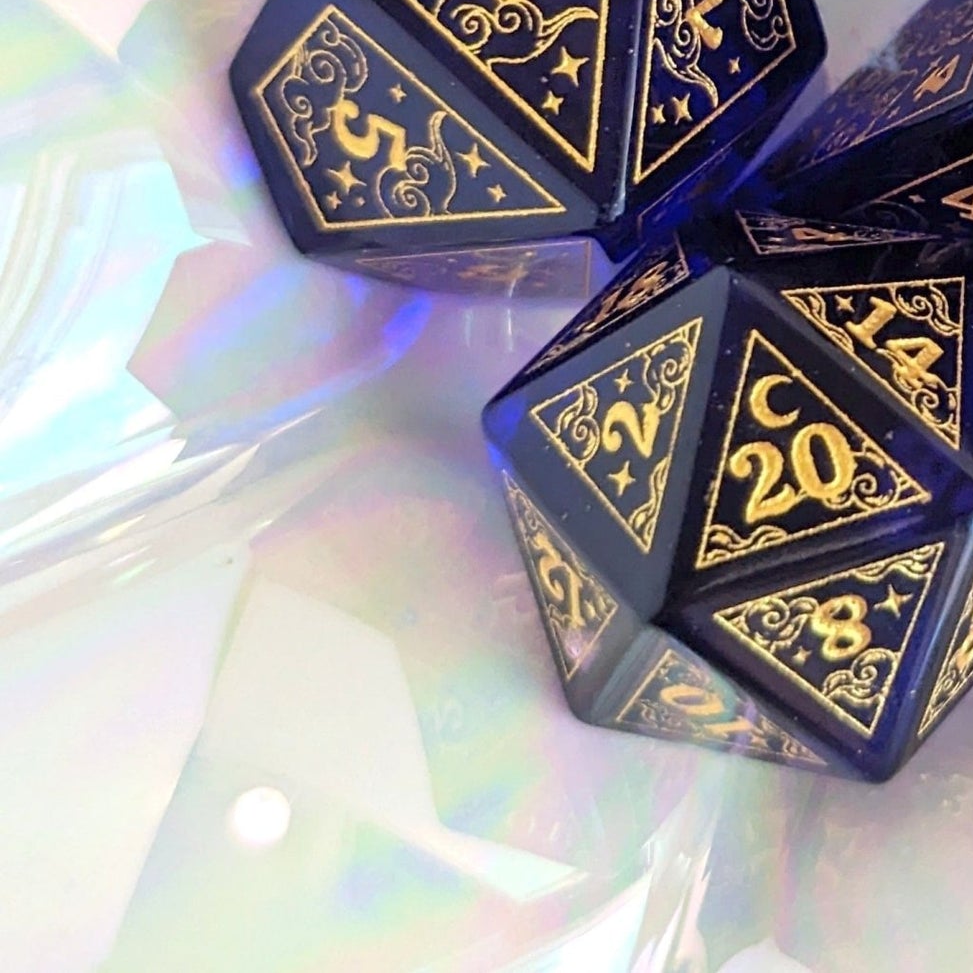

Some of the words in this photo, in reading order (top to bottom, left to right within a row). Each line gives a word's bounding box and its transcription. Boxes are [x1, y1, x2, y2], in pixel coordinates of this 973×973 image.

[913, 55, 960, 102] 4
[334, 100, 406, 170] 5
[845, 297, 944, 390] 14
[602, 398, 659, 457] 2
[730, 423, 855, 521] 20
[811, 594, 873, 662] 8
